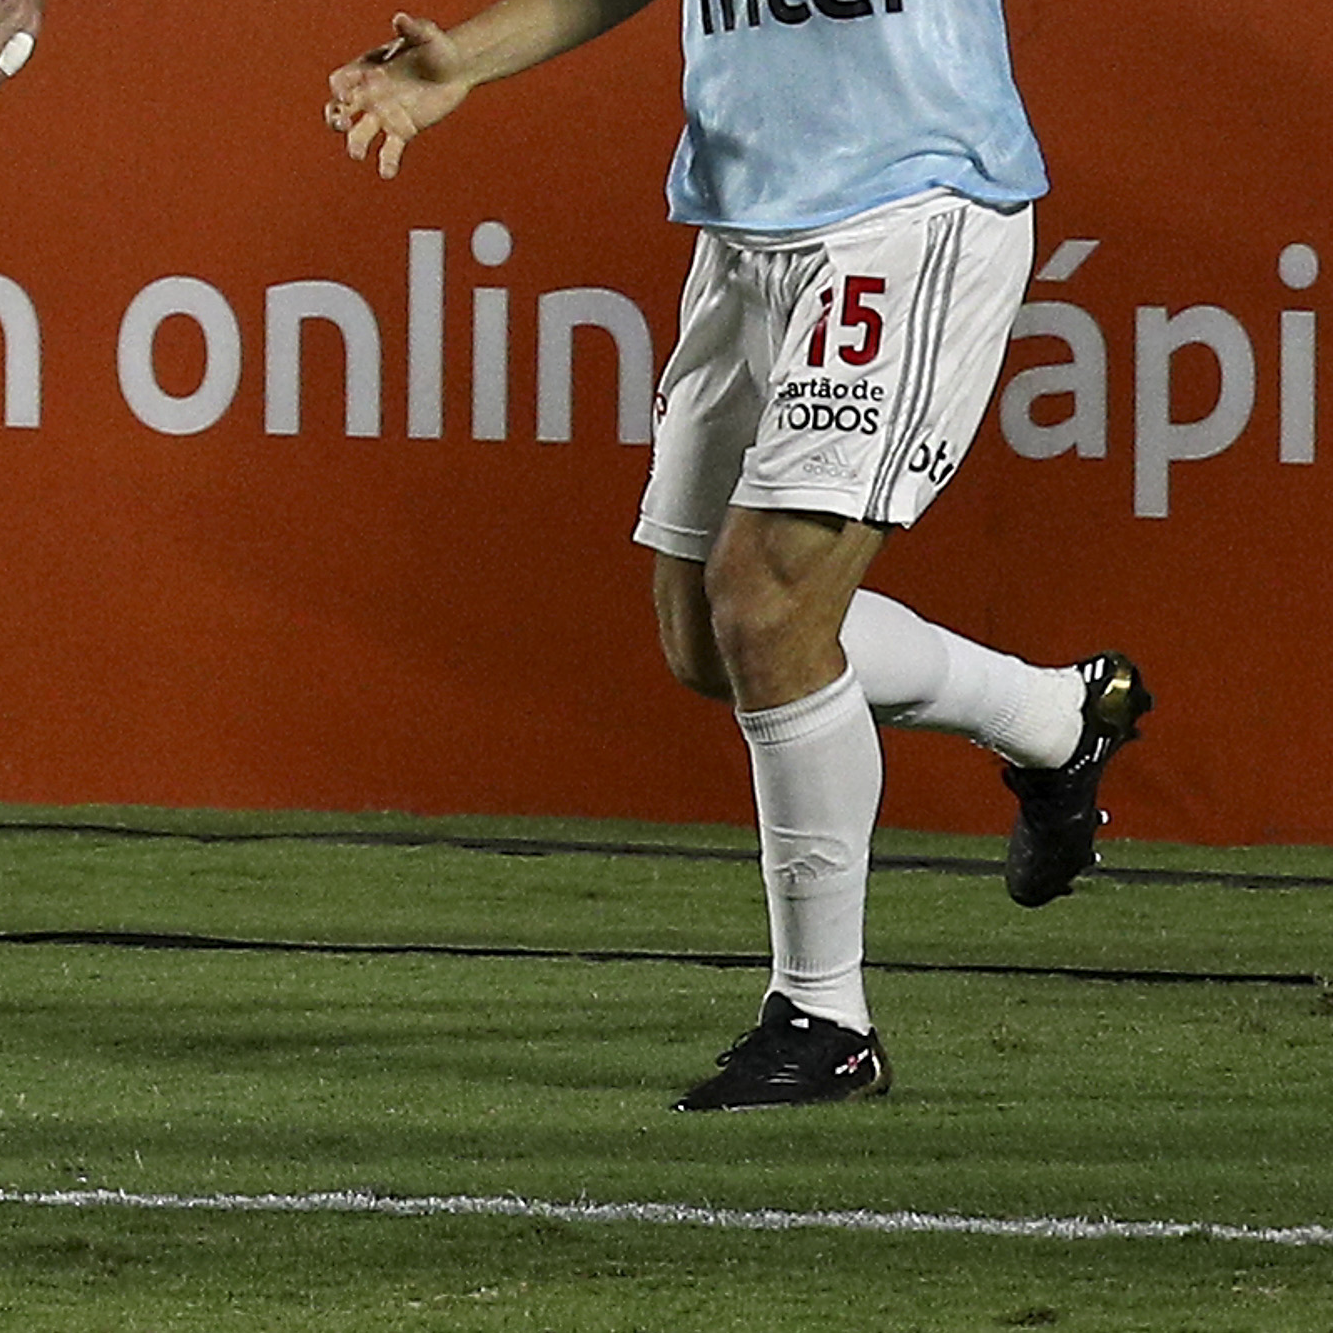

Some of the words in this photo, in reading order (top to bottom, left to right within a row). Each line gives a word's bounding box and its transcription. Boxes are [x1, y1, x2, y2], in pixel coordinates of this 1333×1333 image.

[116, 220, 653, 445] onlin
[806, 274, 886, 367] 15
[852, 379, 884, 401] de
